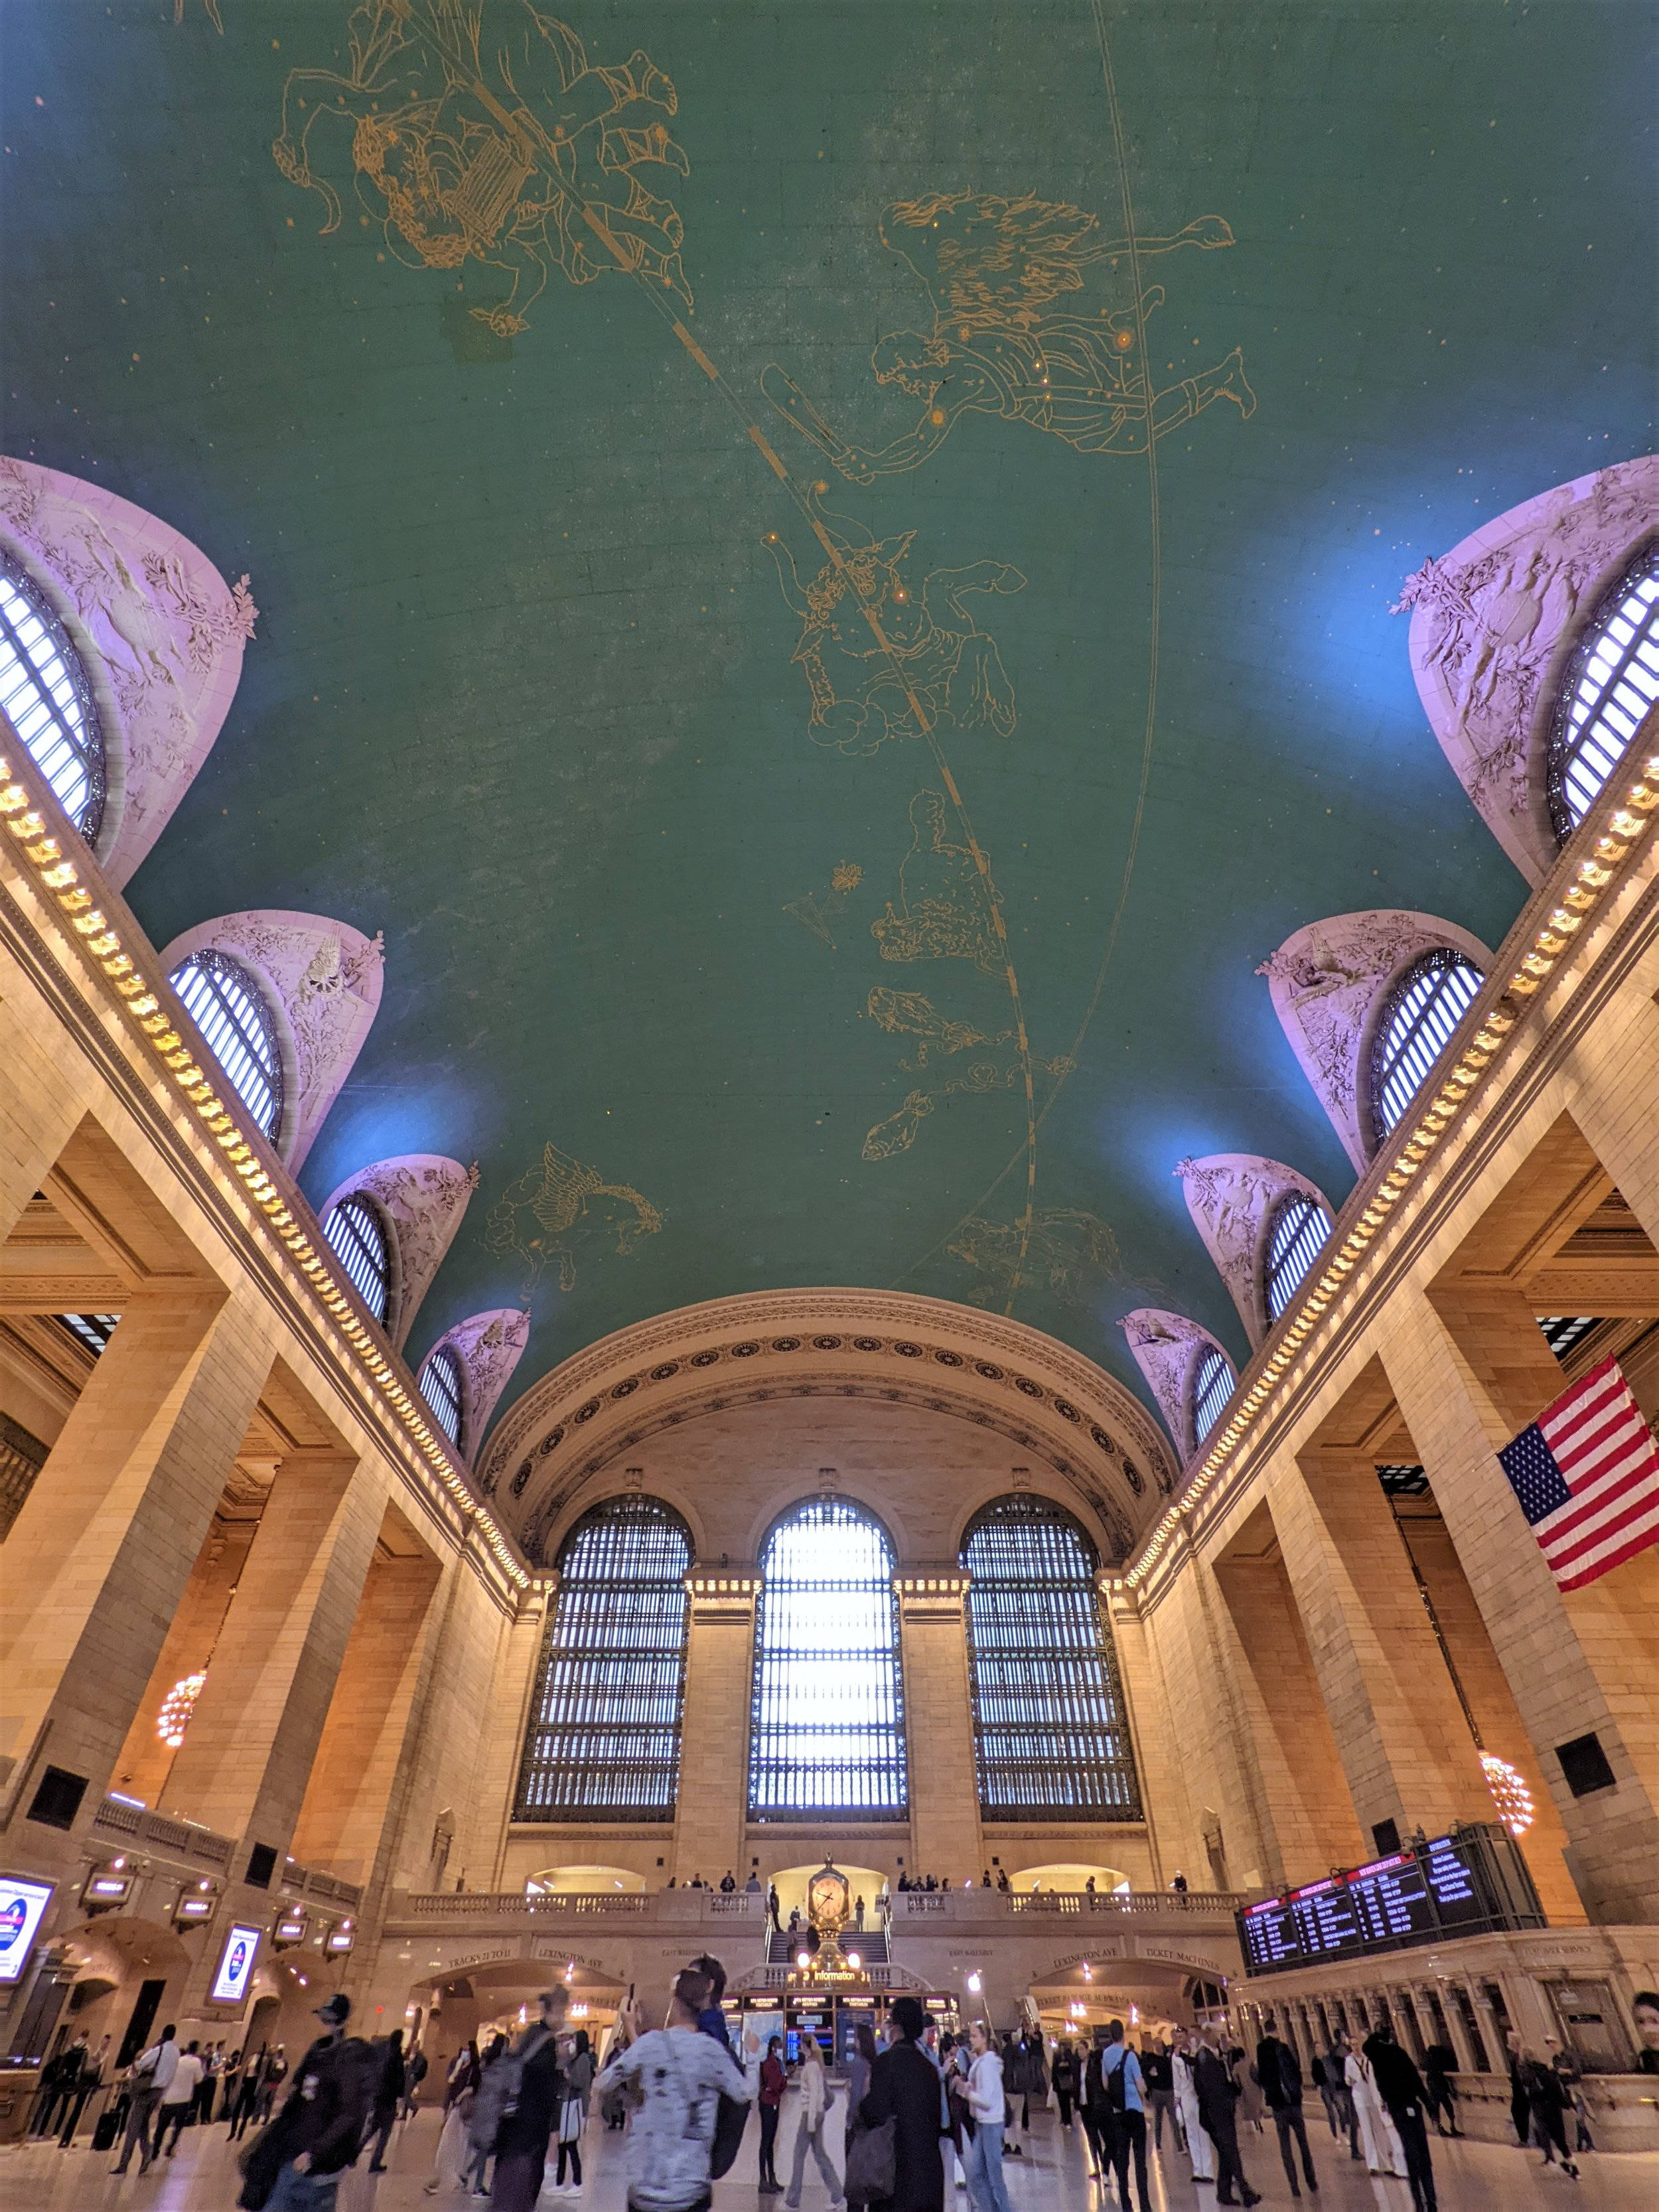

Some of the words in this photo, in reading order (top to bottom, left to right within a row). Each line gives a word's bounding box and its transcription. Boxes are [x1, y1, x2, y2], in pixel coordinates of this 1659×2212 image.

[448, 1954, 480, 1968] TRACKS
[539, 1949, 585, 1963] LEXINGTON
[1054, 1949, 1100, 1968] LEXINGTON
[1102, 1948, 1118, 1956] AVE
[1147, 1949, 1173, 1958] TICKET
[1177, 1953, 1220, 1970] MACHINES
[814, 1969, 855, 1980] Information
